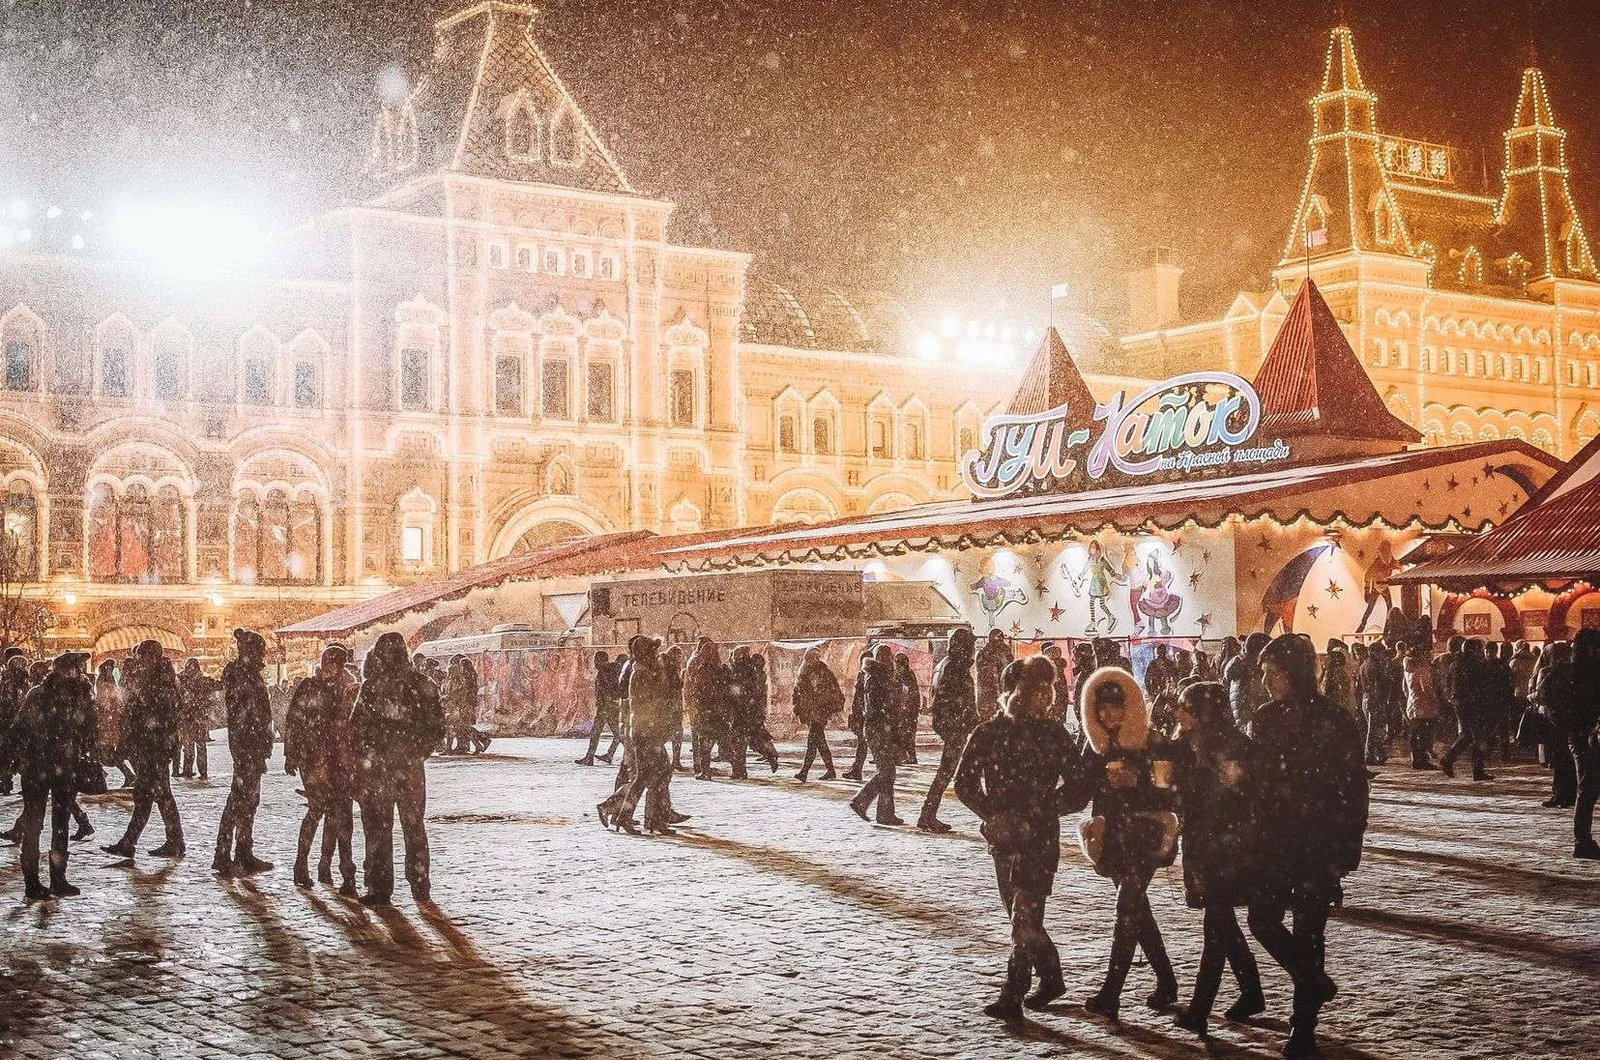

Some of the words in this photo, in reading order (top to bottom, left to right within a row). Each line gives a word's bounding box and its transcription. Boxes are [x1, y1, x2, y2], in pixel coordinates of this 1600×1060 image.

[1158, 454, 1176, 470] на
[1176, 446, 1231, 473] Красной
[1233, 438, 1290, 463] площади
[622, 588, 726, 608] ТЕЛЕВИДЕНИЕ
